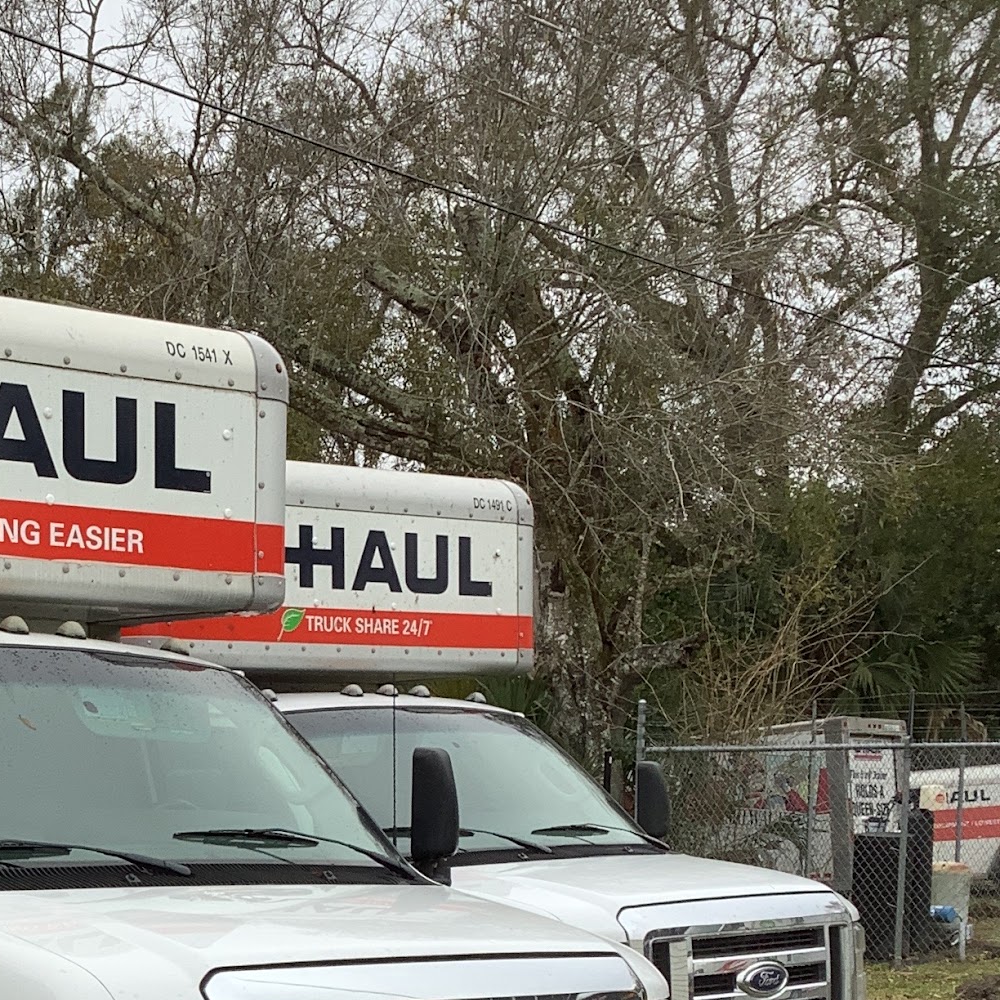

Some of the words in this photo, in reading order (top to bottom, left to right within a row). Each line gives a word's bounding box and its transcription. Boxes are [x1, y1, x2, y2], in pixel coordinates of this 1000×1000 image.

[166, 341, 186, 358] DC
[192, 345, 217, 363] 1541
[222, 350, 233, 365] X
[473, 497, 486, 509] DC
[506, 500, 512, 511] C
[50, 522, 144, 554] EASIER
[305, 615, 352, 633] TRUCK
[355, 617, 399, 634] SHARE
[402, 619, 432, 637] 24/7
[758, 971, 780, 987] Ford
